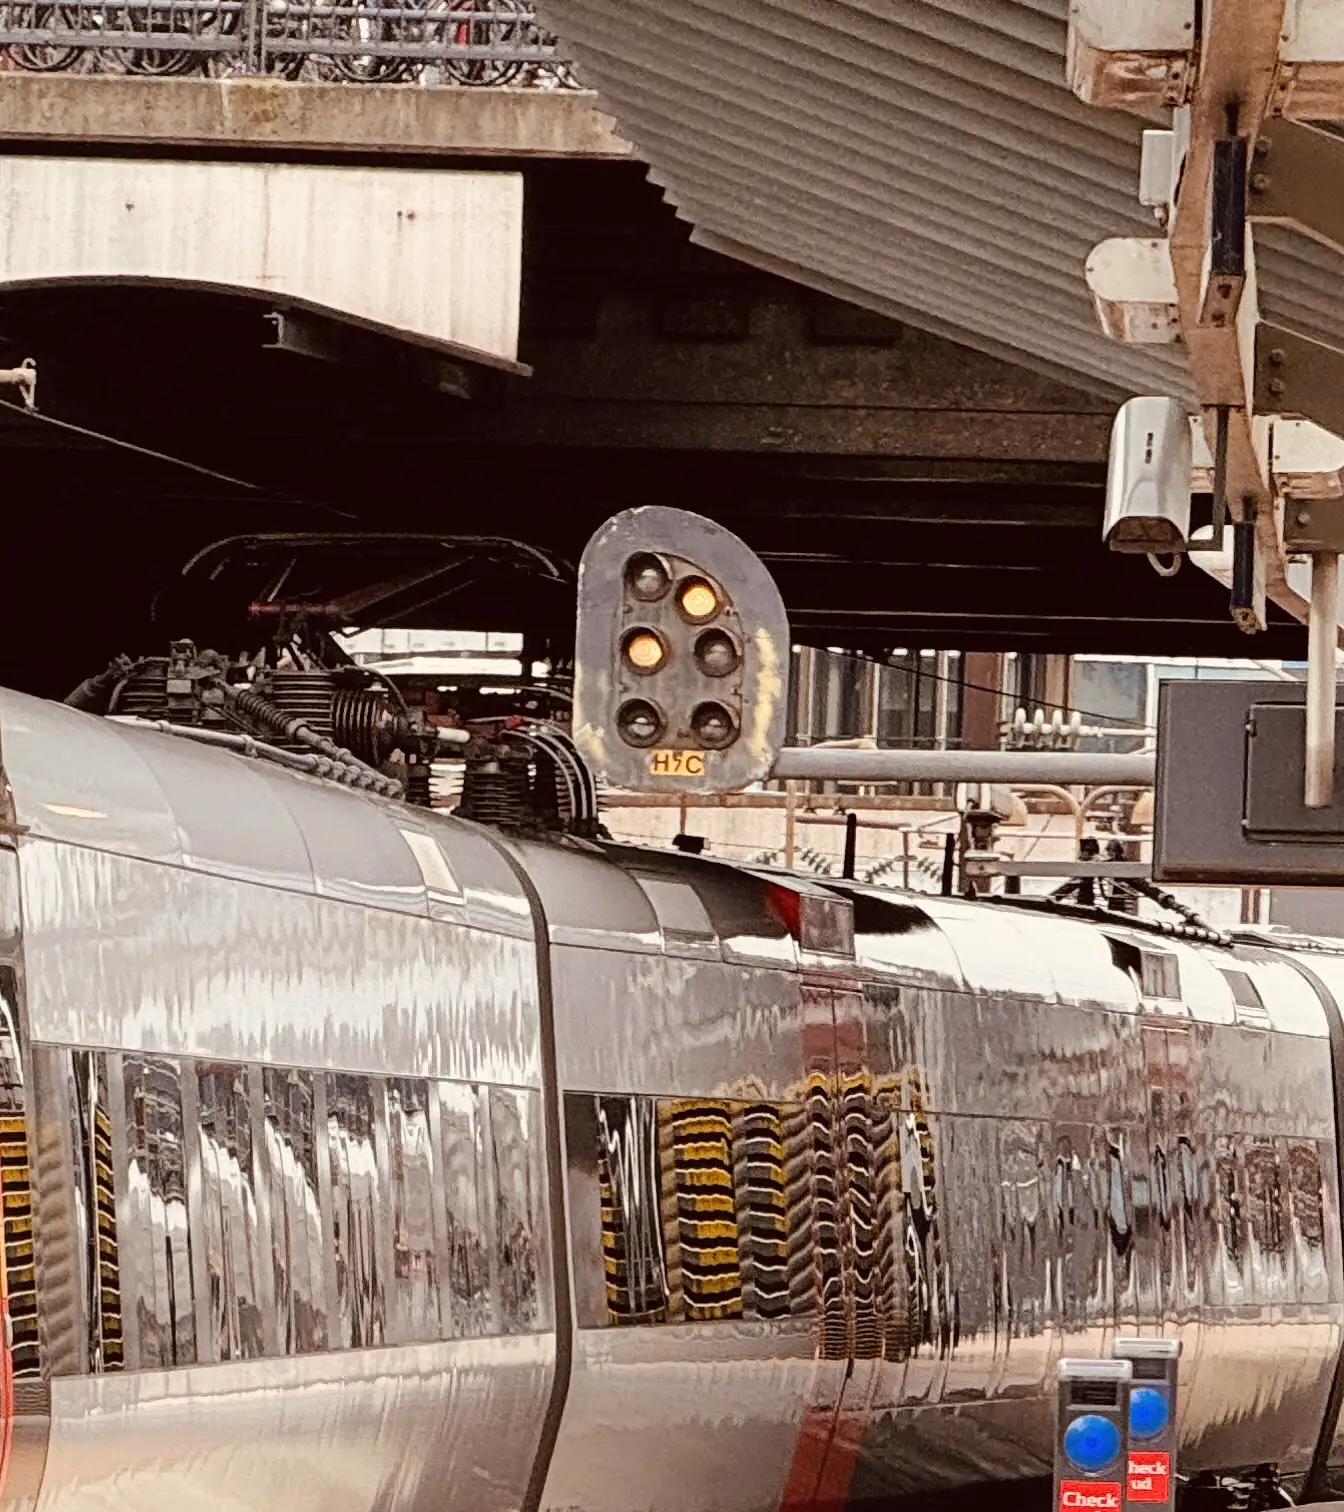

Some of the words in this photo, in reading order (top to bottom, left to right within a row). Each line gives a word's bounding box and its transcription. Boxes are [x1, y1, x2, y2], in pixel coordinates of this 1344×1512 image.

[1128, 1461, 1168, 1475] heck
[1131, 1477, 1152, 1490] ud
[1063, 1491, 1118, 1508] Check
